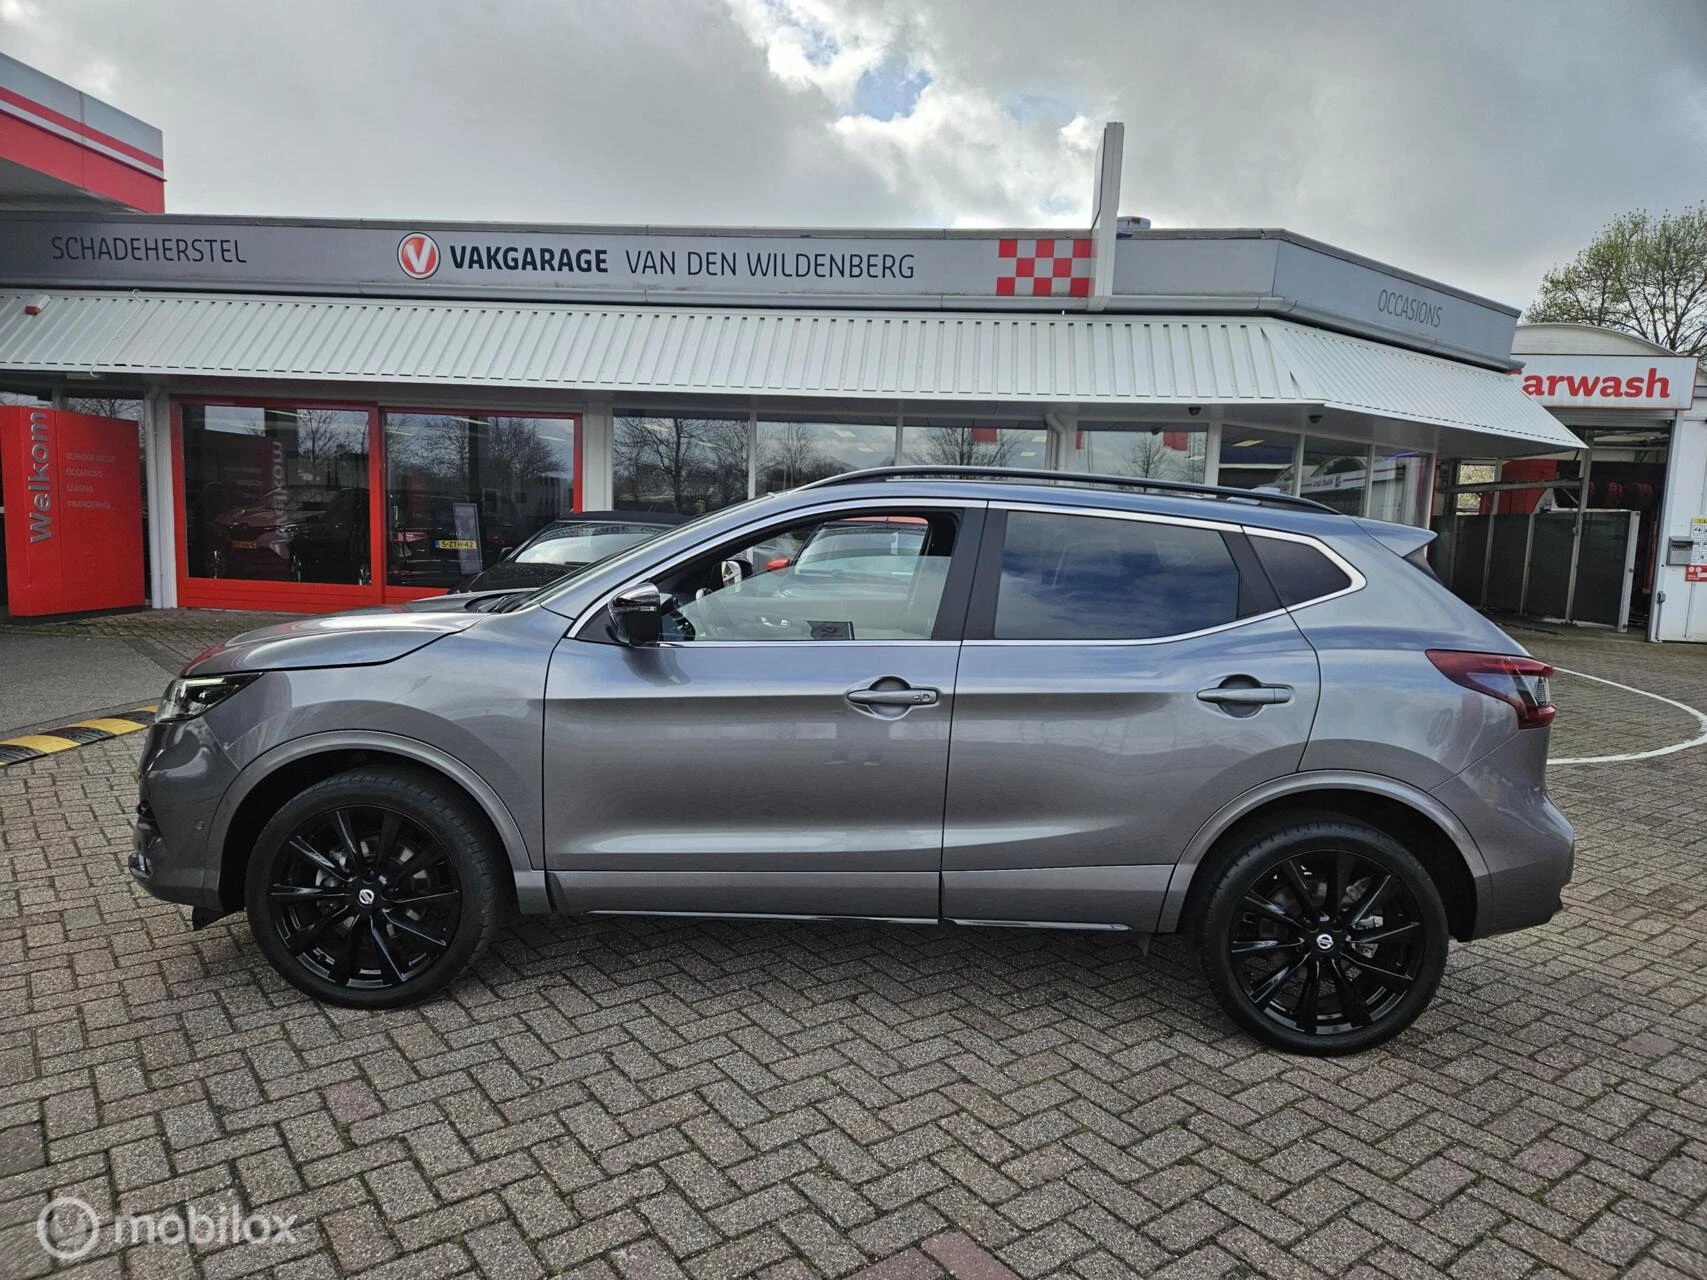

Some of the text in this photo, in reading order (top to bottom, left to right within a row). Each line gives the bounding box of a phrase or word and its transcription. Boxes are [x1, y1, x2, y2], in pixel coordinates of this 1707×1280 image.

[51, 236, 248, 264] SCHADEHERSTEL
[449, 245, 608, 274] VAKGARAGE
[625, 250, 676, 276] VAN
[687, 251, 737, 277] DEN
[747, 252, 915, 279] WILDENBERG
[1377, 289, 1442, 328] OCCASIONS
[1512, 368, 1670, 400] arwash
[28, 411, 52, 543] Welkom
